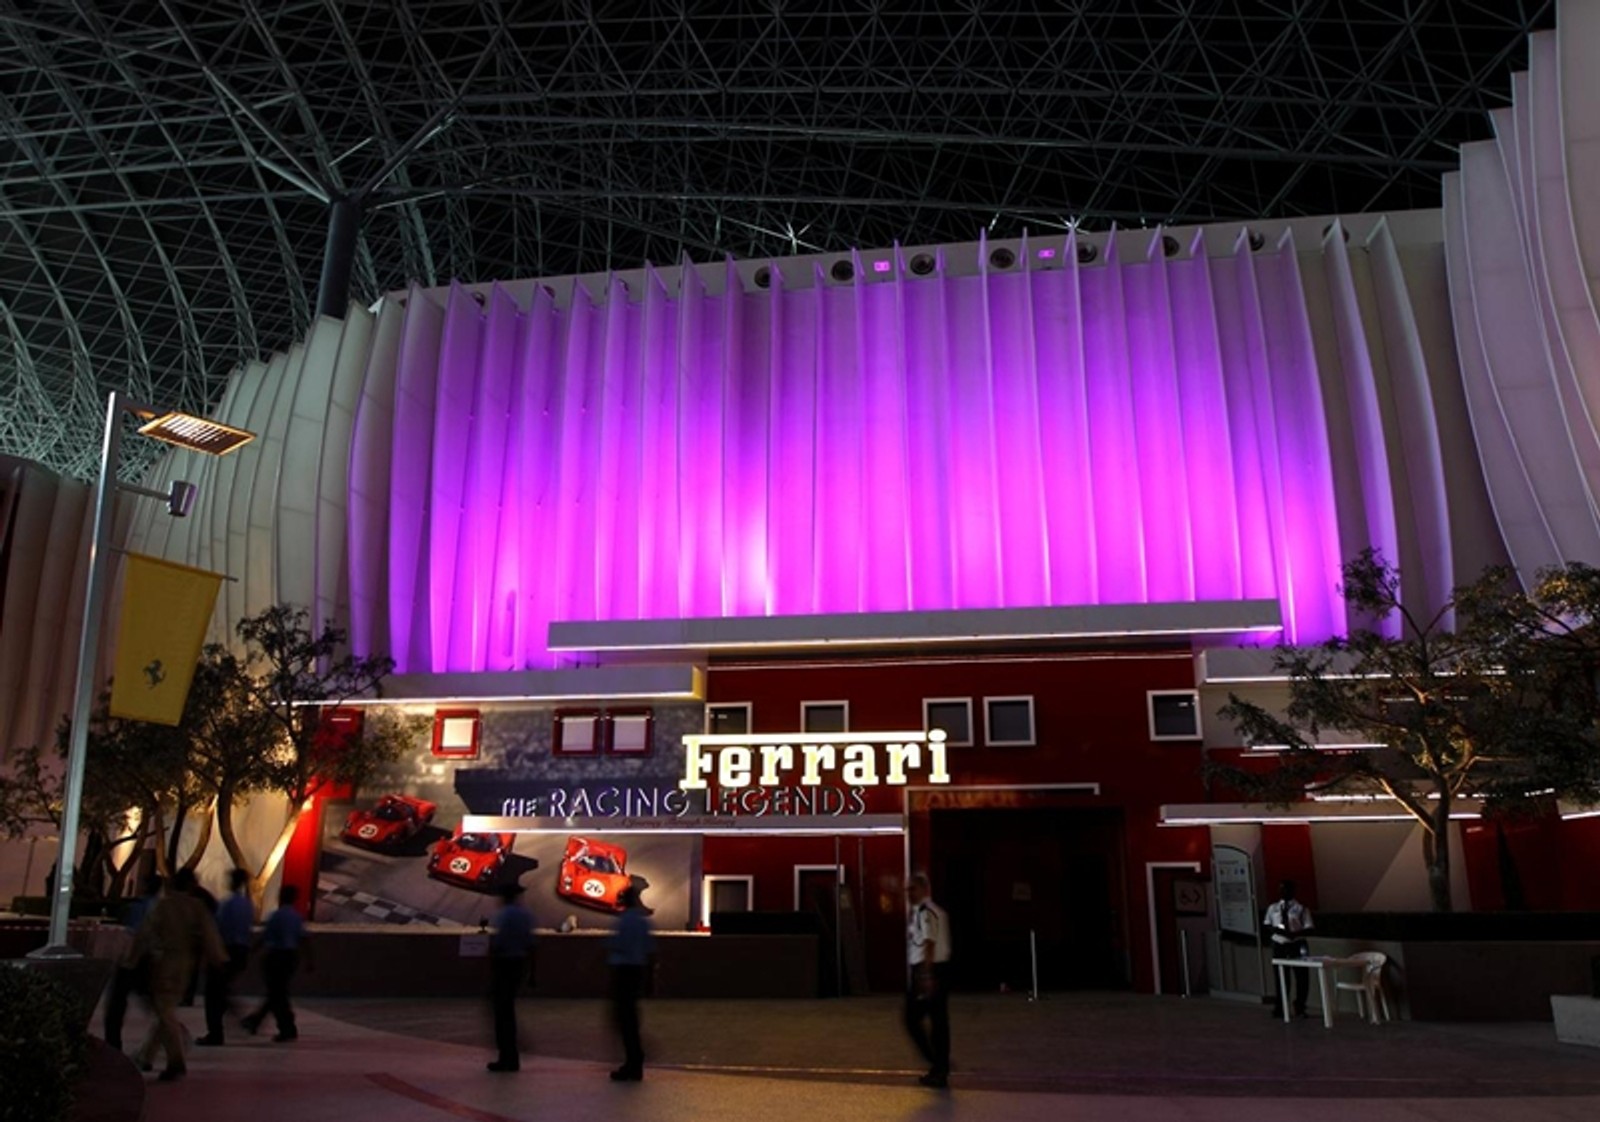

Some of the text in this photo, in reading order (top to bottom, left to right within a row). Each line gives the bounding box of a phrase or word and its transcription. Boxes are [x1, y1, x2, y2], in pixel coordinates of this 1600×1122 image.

[679, 729, 950, 790] Ferrari
[502, 785, 866, 817] THE RACING LEGENDS
[453, 859, 469, 871] 24
[586, 882, 603, 894] 26
